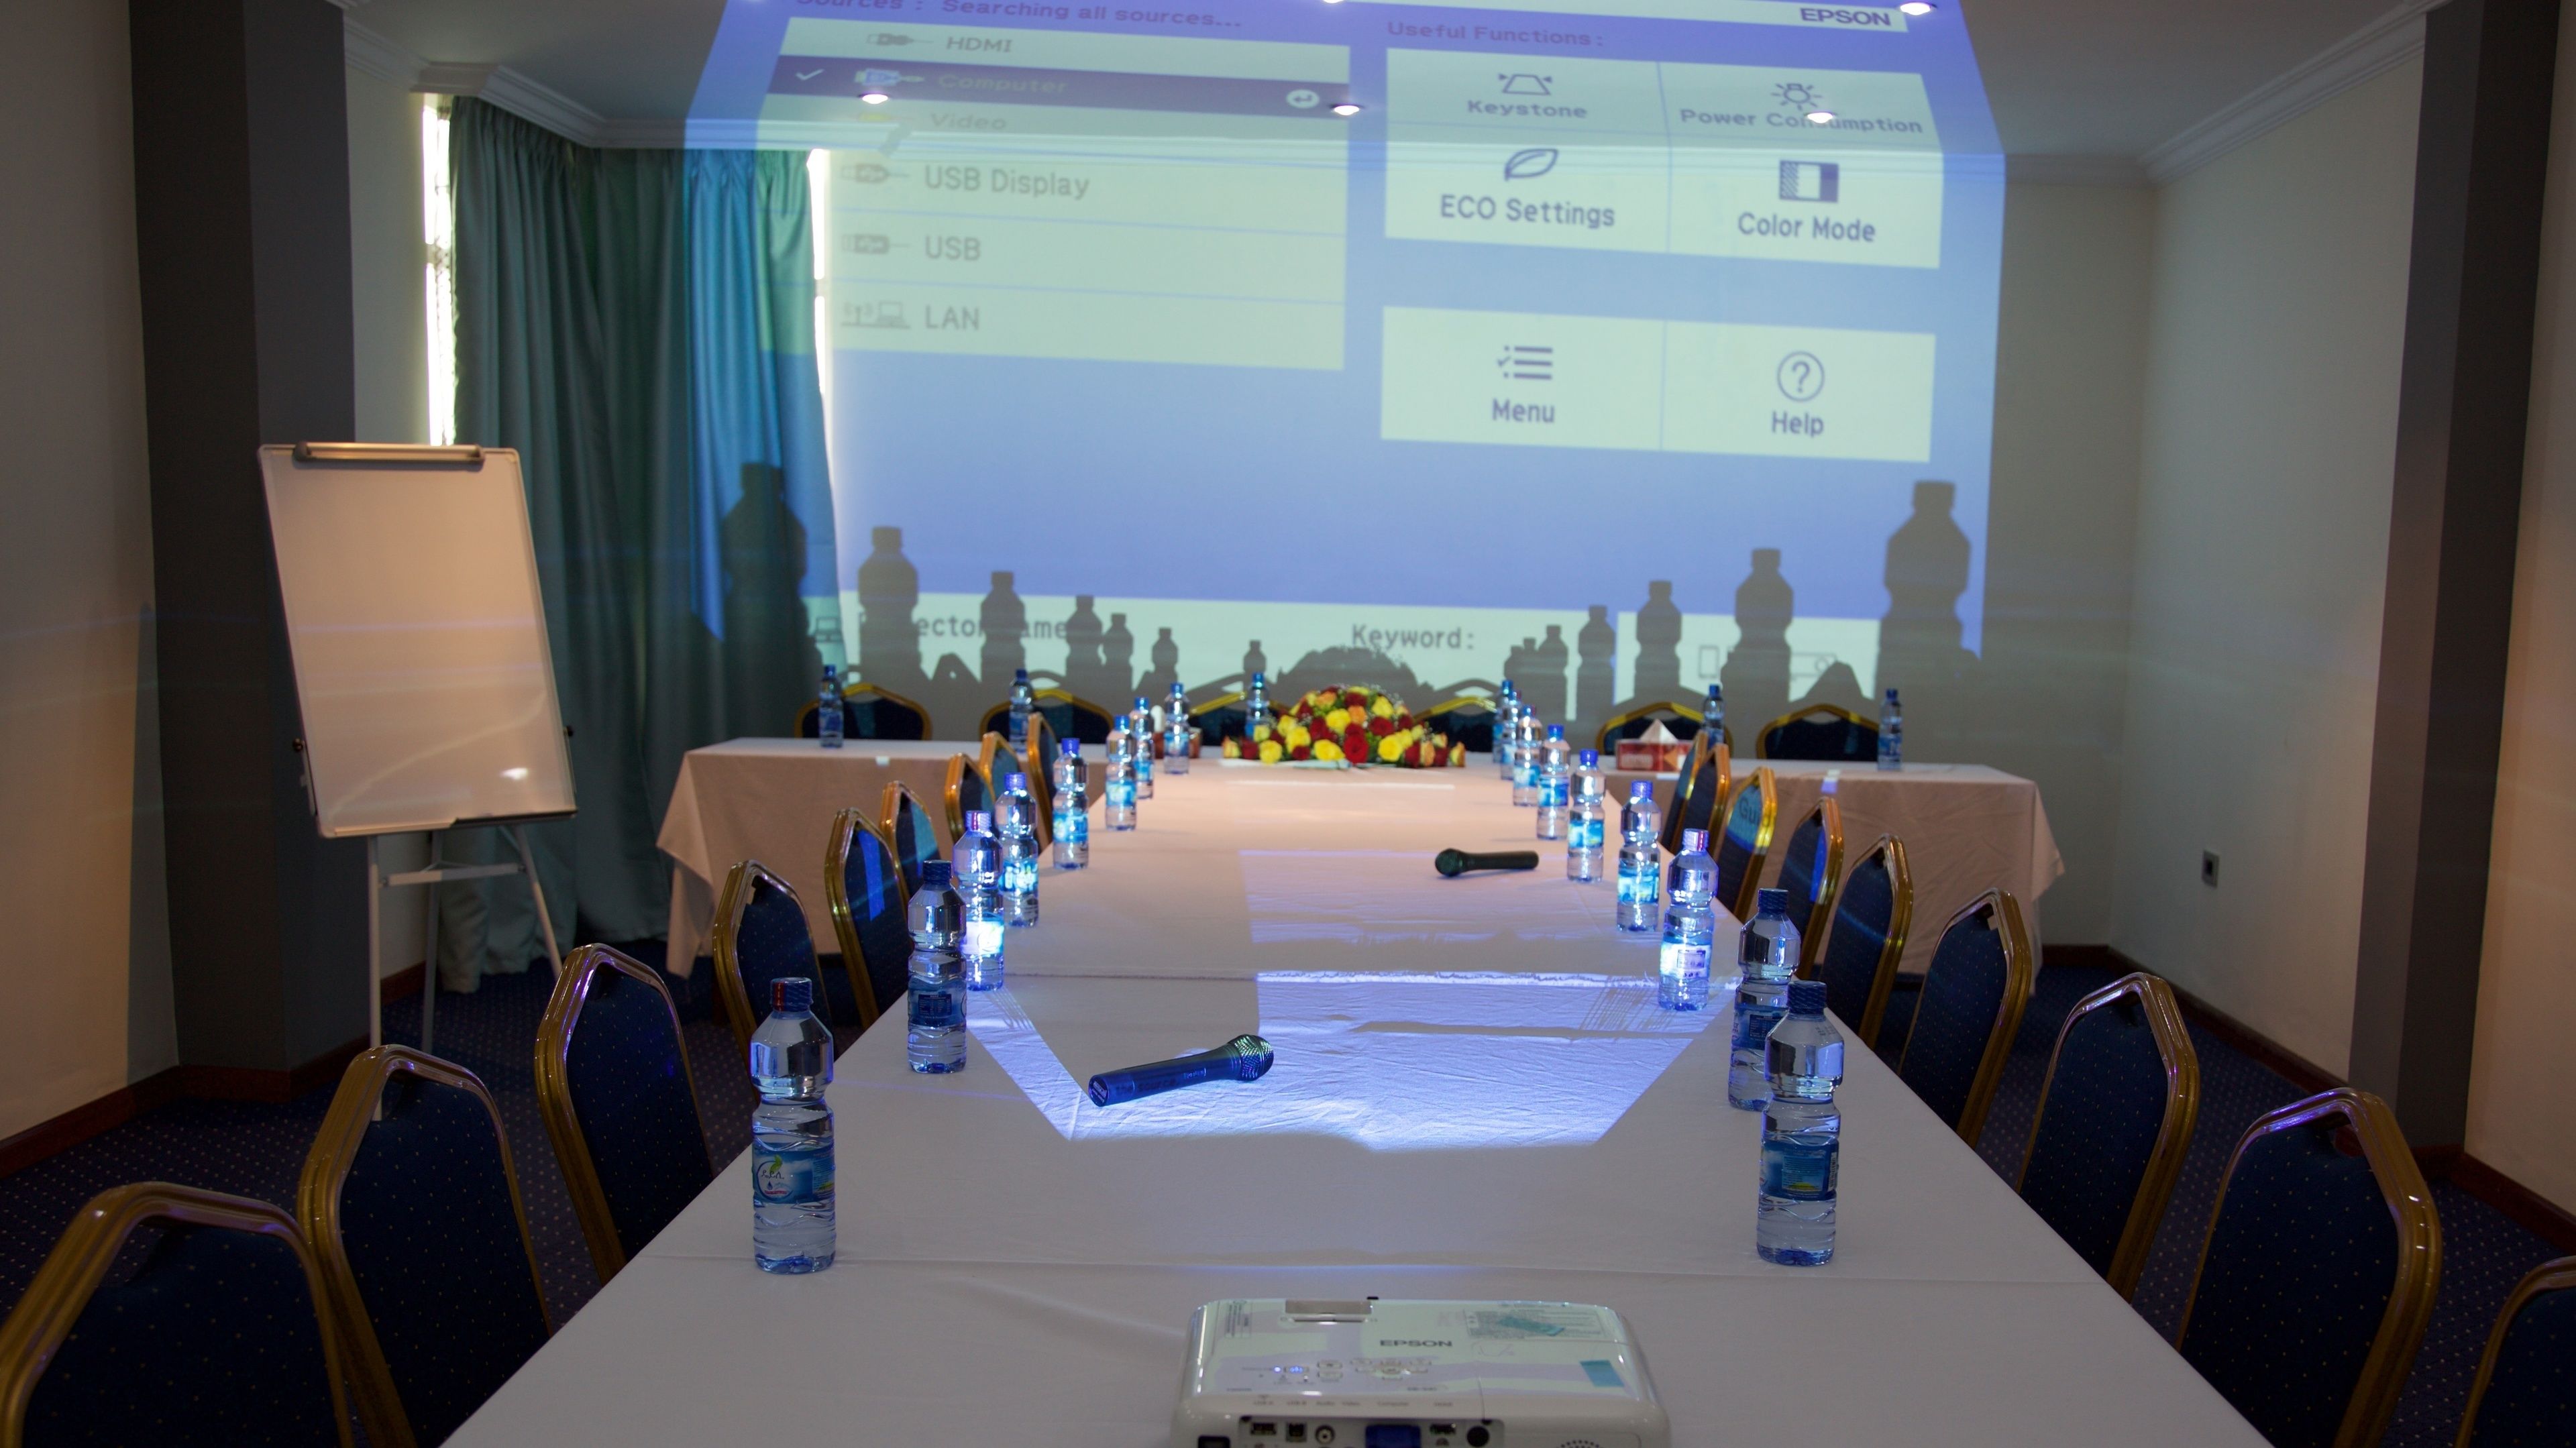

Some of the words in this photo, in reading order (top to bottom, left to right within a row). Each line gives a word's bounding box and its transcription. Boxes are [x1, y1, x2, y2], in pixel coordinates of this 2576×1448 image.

[943, 0, 1069, 19] Searching
[1078, 6, 1106, 19] all
[1115, 9, 1240, 27] sources...
[1800, 7, 1891, 26] EPSON
[1387, 21, 1465, 39] Useful
[946, 36, 1012, 54] HDMI
[940, 74, 1068, 93] Computer
[930, 113, 1006, 129] Video
[1468, 100, 1587, 119] Keystone
[1680, 109, 1755, 126] Power
[924, 165, 981, 192] USB
[991, 168, 1090, 200] Display
[1440, 194, 1496, 219] ECO
[1506, 198, 1615, 229] Settings
[1737, 212, 1803, 237] Color
[1813, 215, 1876, 242] Mode
[924, 235, 981, 261] USB
[924, 304, 980, 330] LAN
[1492, 399, 1554, 423] Menu
[1772, 410, 1824, 437] Help
[1352, 623, 1474, 651] Keyword:
[1379, 1339, 1453, 1347] EPSON
